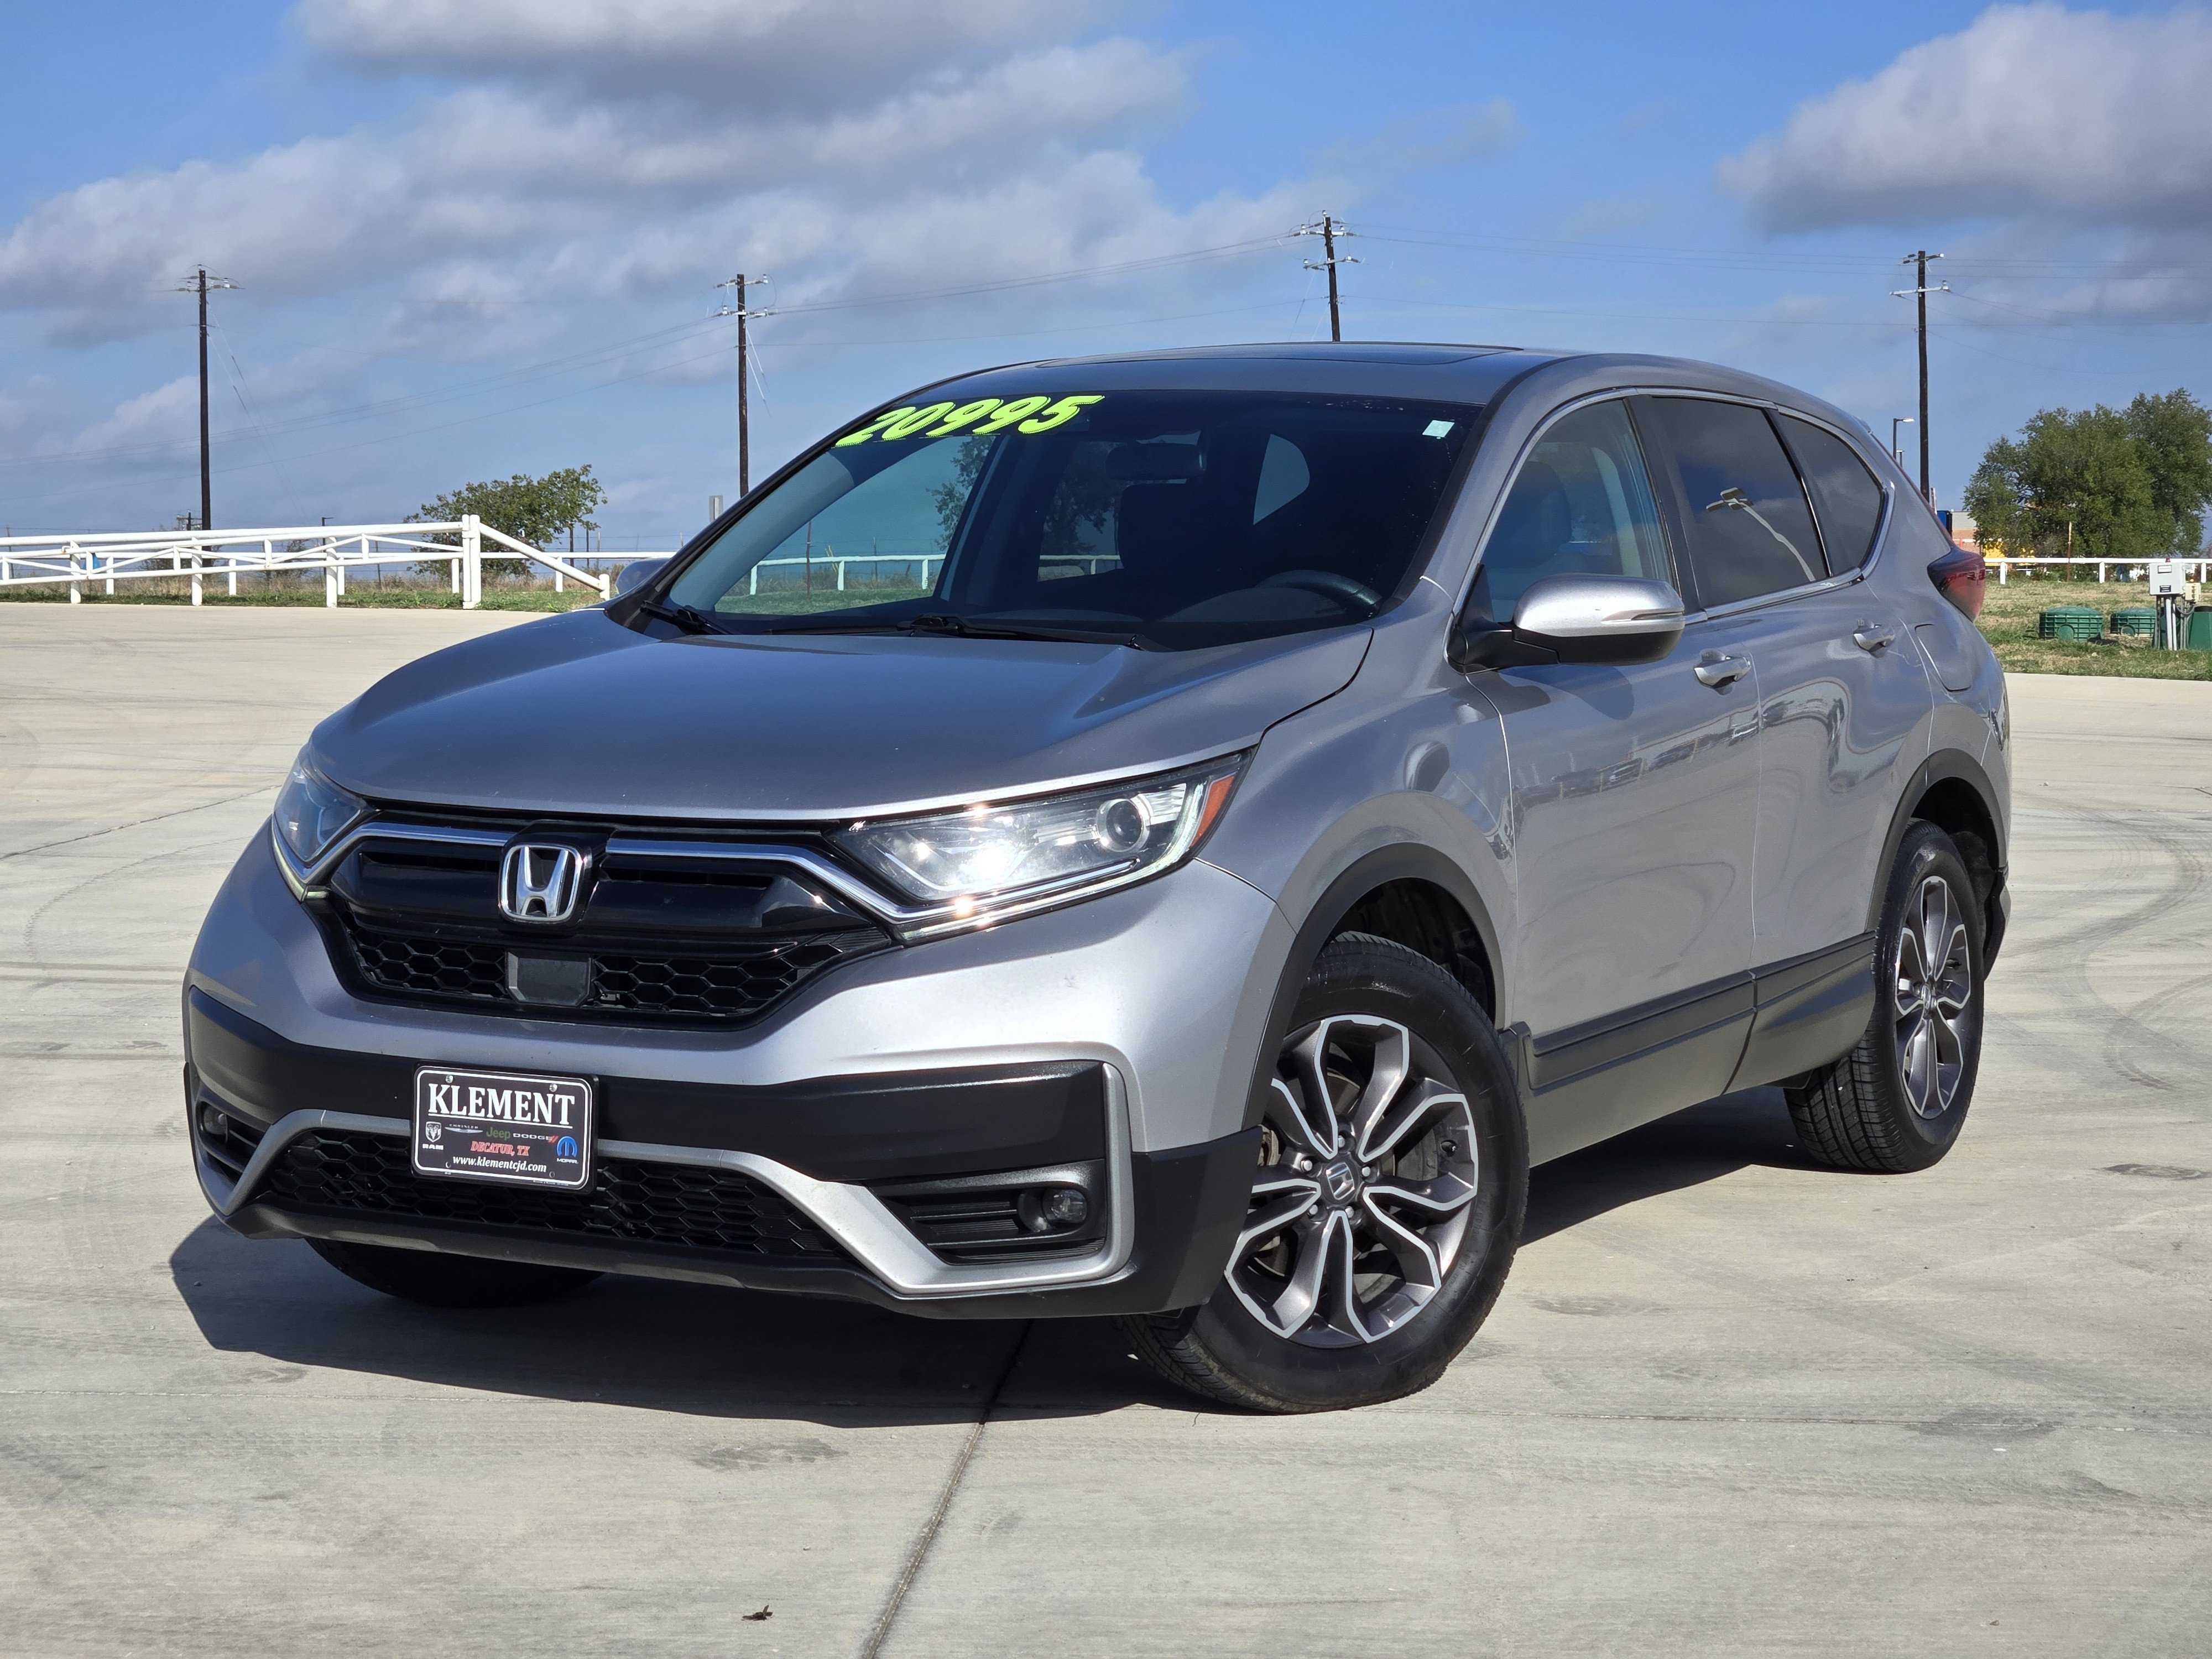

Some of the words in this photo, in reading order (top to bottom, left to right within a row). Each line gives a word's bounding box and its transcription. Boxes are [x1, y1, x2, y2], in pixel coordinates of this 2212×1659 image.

[835, 395, 1105, 447] 20995
[428, 1083, 575, 1125] KLEMENT
[486, 1126, 510, 1140] Jeep
[471, 1141, 515, 1156] DECATUR,
[517, 1145, 530, 1156] TX
[453, 1156, 547, 1172] www.klementcjd.com
